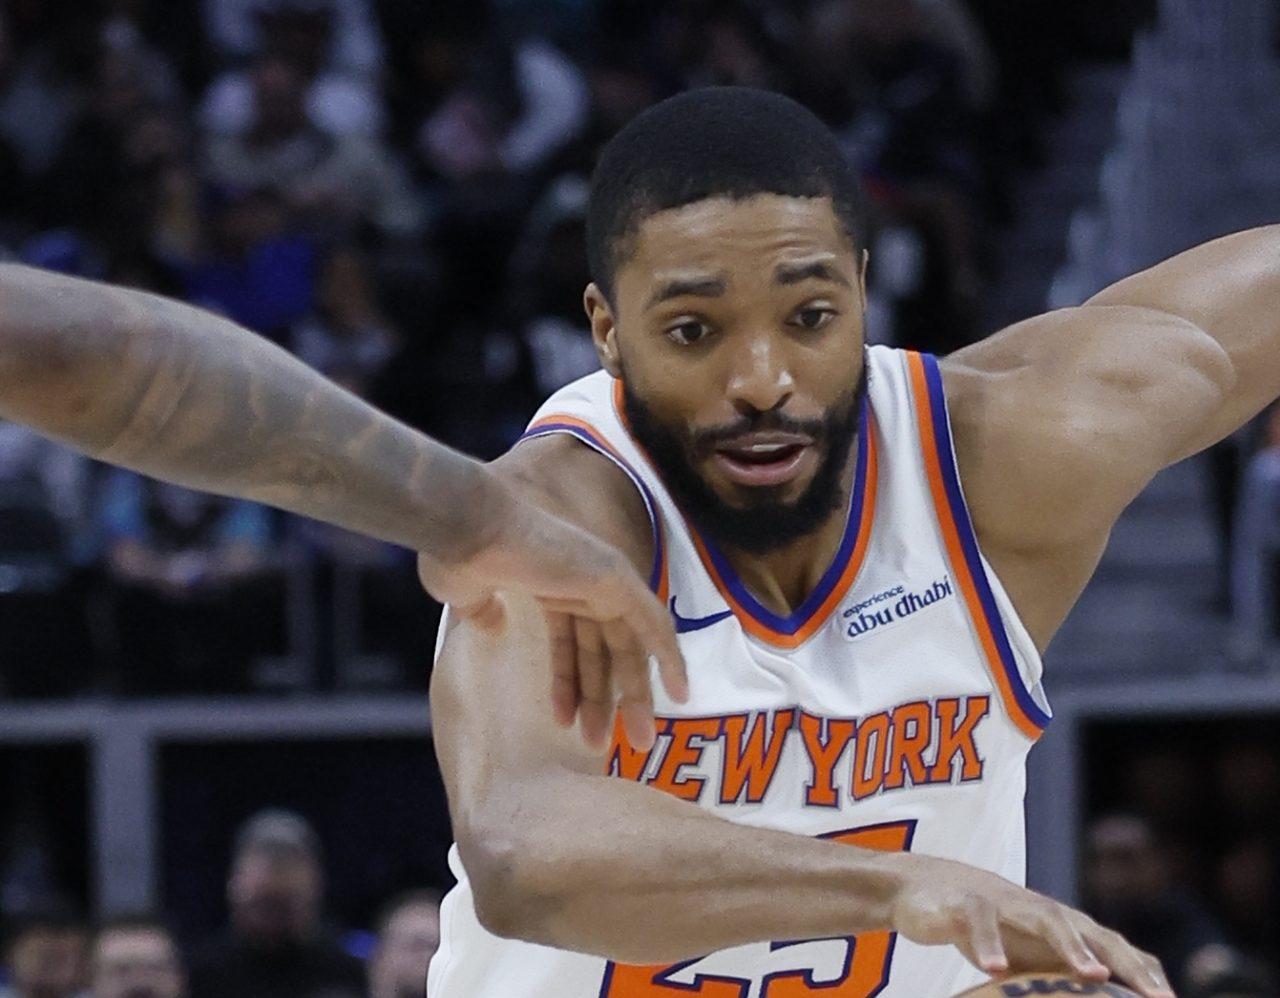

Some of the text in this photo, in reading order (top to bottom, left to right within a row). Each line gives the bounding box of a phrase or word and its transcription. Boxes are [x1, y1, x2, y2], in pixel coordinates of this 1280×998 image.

[843, 585, 904, 618] experience
[847, 575, 952, 638] abu dhabi
[799, 694, 990, 808] YORK
